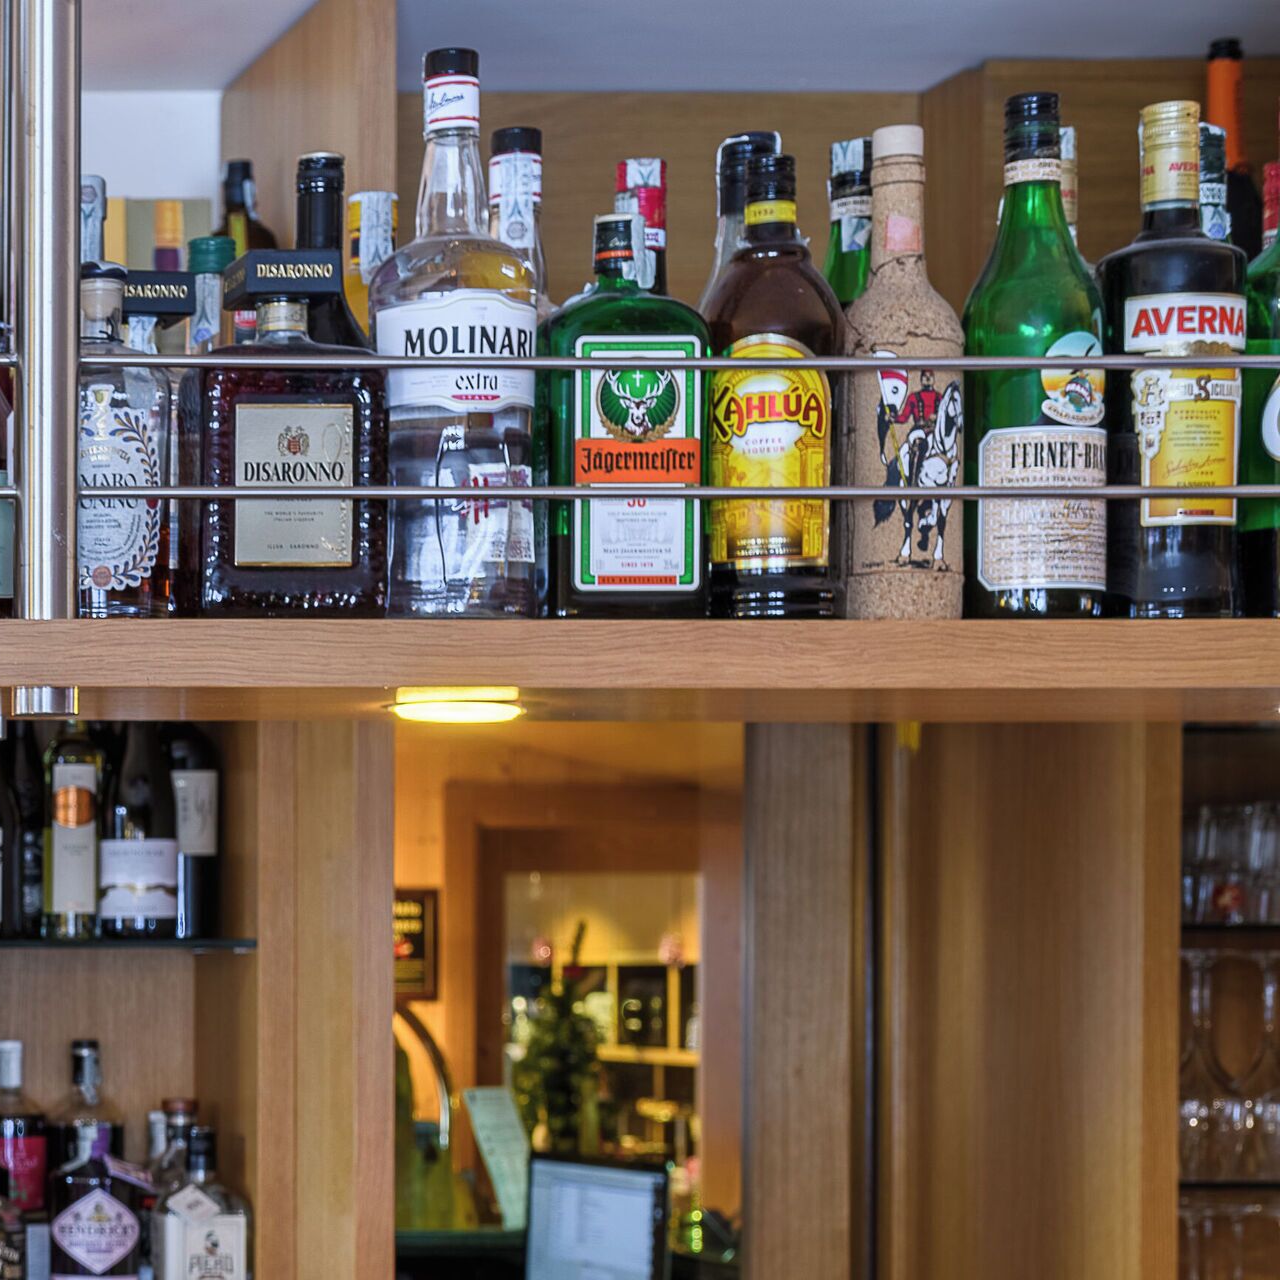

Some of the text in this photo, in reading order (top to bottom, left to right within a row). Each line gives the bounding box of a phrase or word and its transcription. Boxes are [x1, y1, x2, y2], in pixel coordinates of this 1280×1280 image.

[256, 262, 334, 278] DISARONNO
[123, 284, 188, 299] ISARONNO
[1132, 305, 1245, 338] AVERNA
[404, 325, 533, 357] MOLINARI
[455, 372, 499, 391] extra
[712, 385, 827, 441] KAHLÚA
[244, 461, 345, 483] DISARONNO
